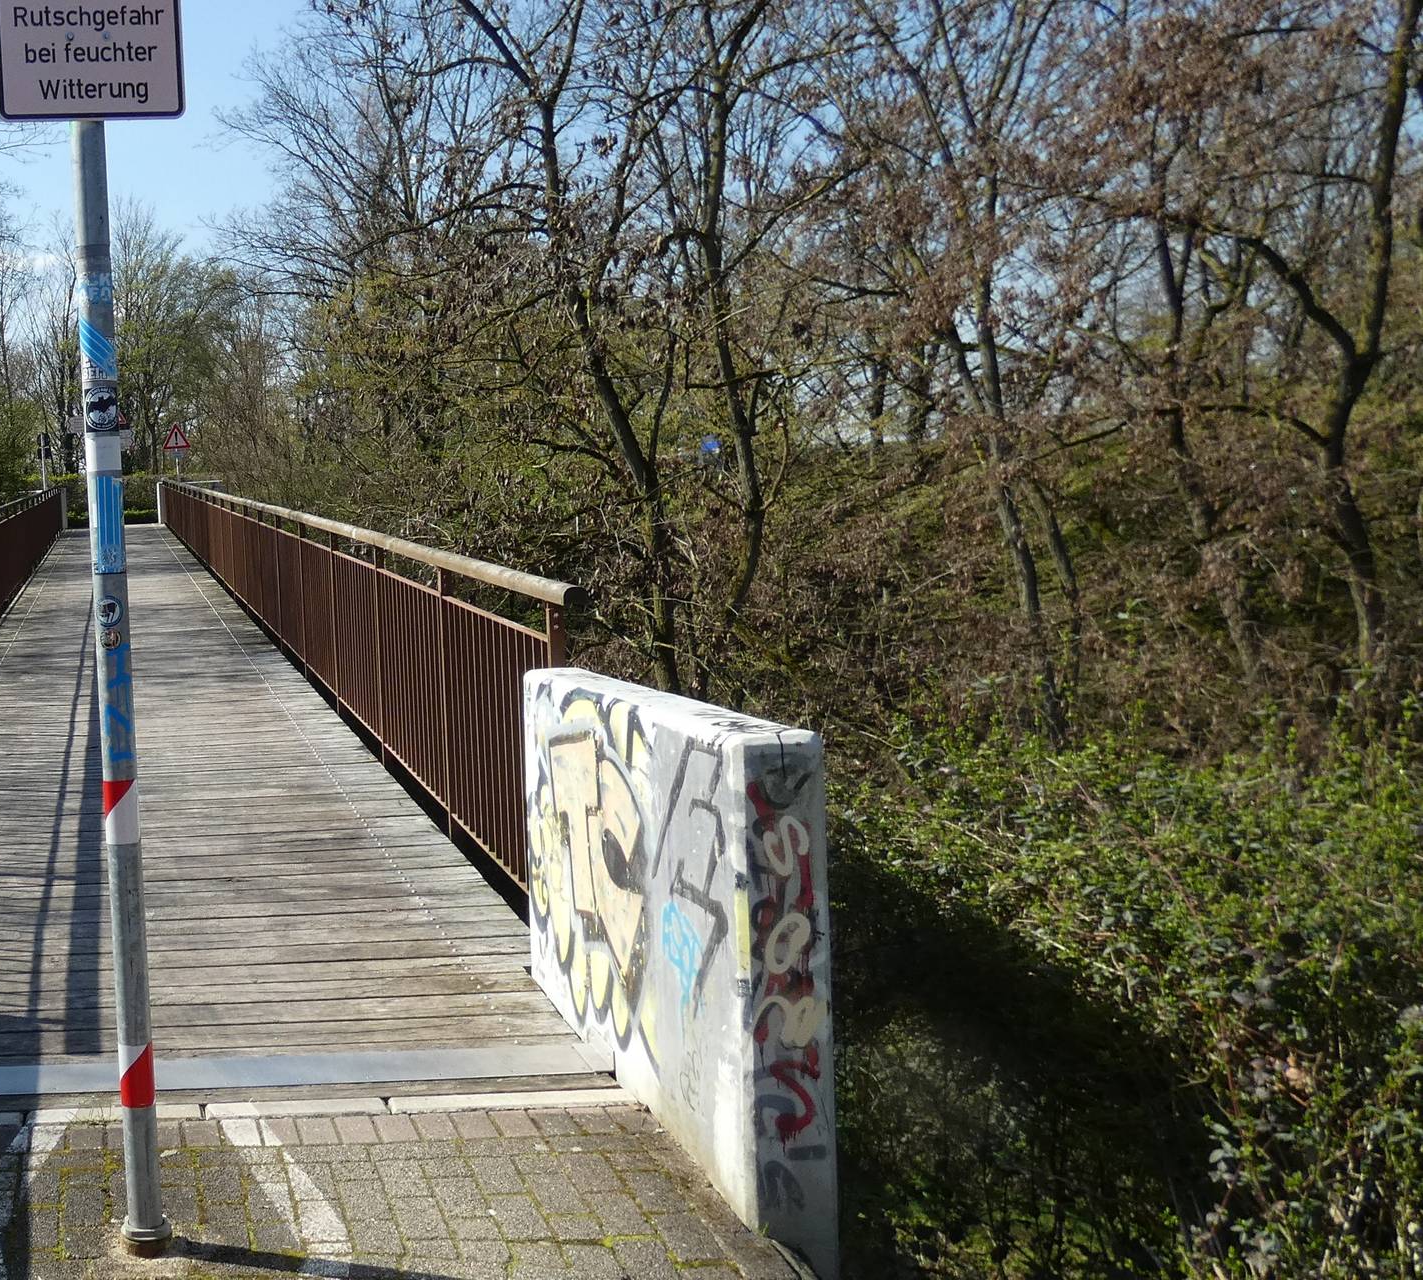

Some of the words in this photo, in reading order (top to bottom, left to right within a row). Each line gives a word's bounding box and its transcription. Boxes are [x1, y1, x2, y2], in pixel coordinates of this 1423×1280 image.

[13, 5, 165, 32] Rutschgefahr
[24, 42, 57, 64] bei
[64, 40, 158, 63] feuchter
[38, 78, 150, 104] Witterung
